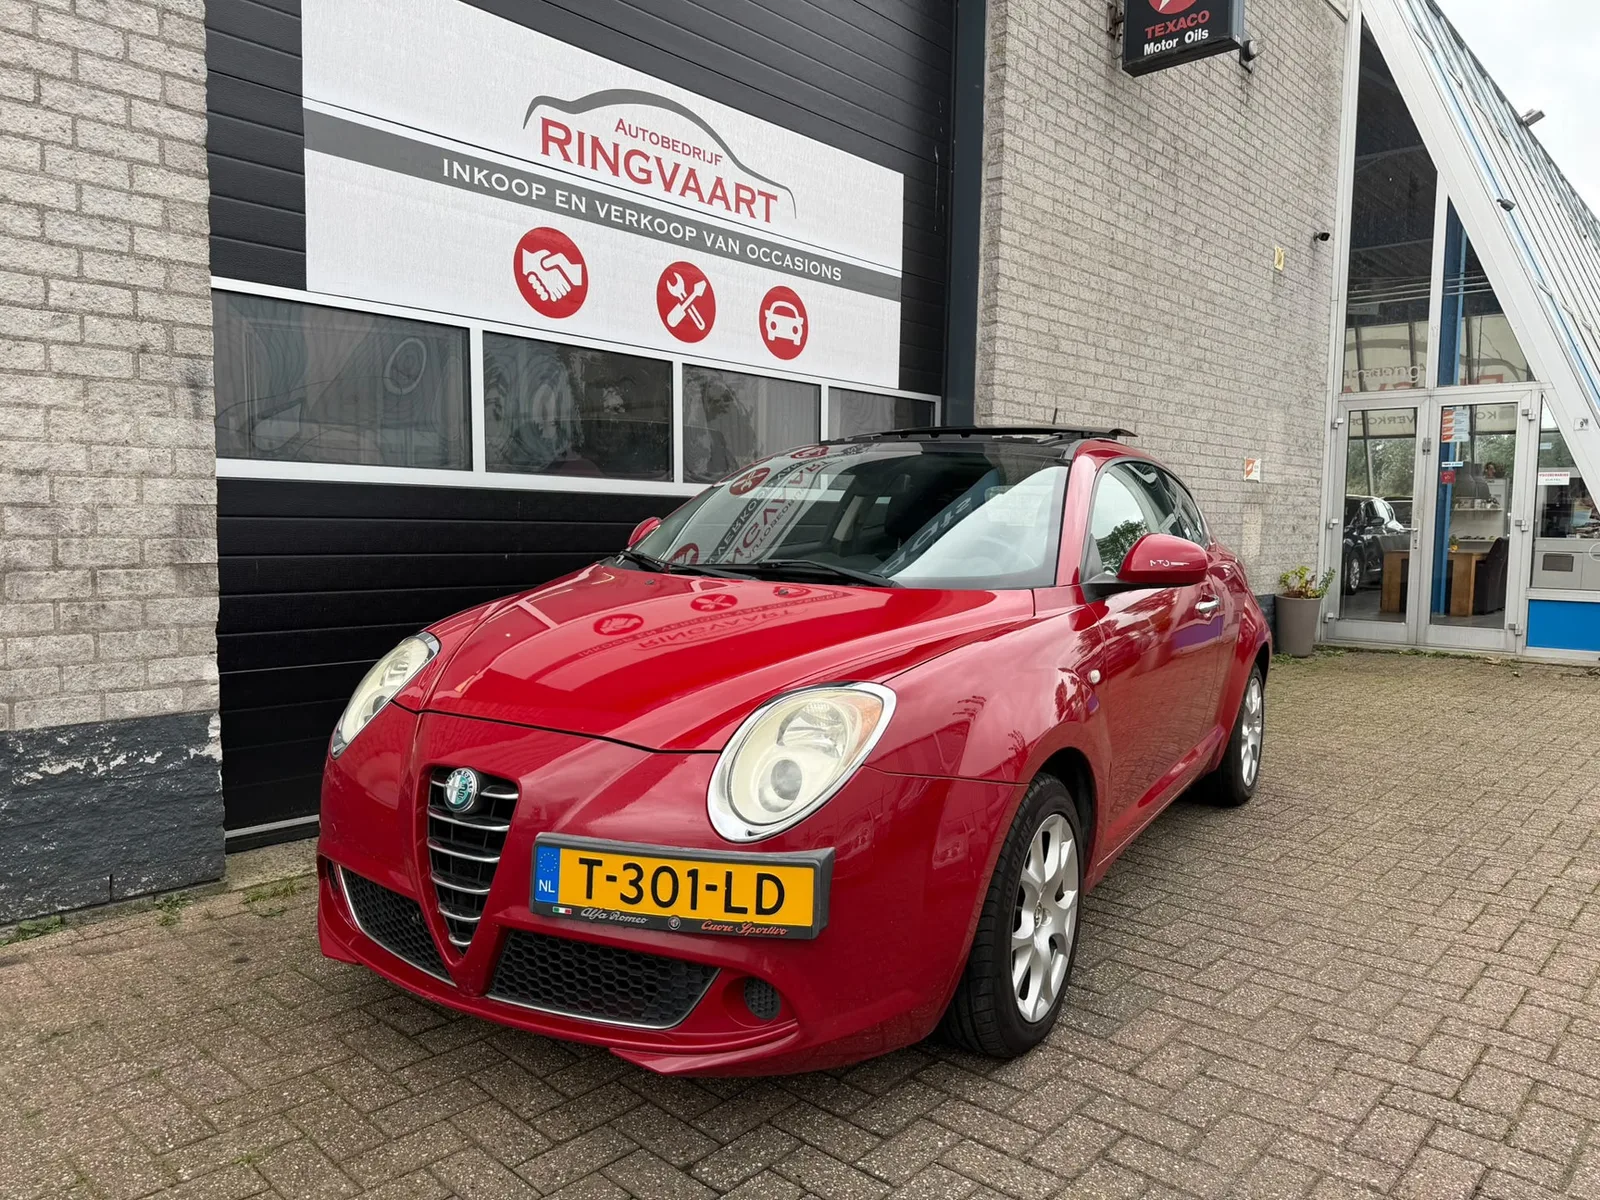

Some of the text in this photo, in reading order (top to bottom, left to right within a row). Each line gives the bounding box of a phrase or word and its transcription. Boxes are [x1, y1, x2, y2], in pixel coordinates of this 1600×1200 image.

[1144, 10, 1211, 39] TEXACO
[1143, 28, 1209, 56] Motor Oils
[614, 118, 723, 167] AUTOBEDRIJF
[540, 116, 779, 224] RINGVAART
[442, 158, 843, 282] INKOOP EN VERKOOP VAN OCCASIONS
[538, 878, 556, 894] NL
[578, 857, 786, 916] T-301-LD
[580, 907, 648, 924] Alfa Romeo
[701, 919, 789, 936] Cuore Sportivo
